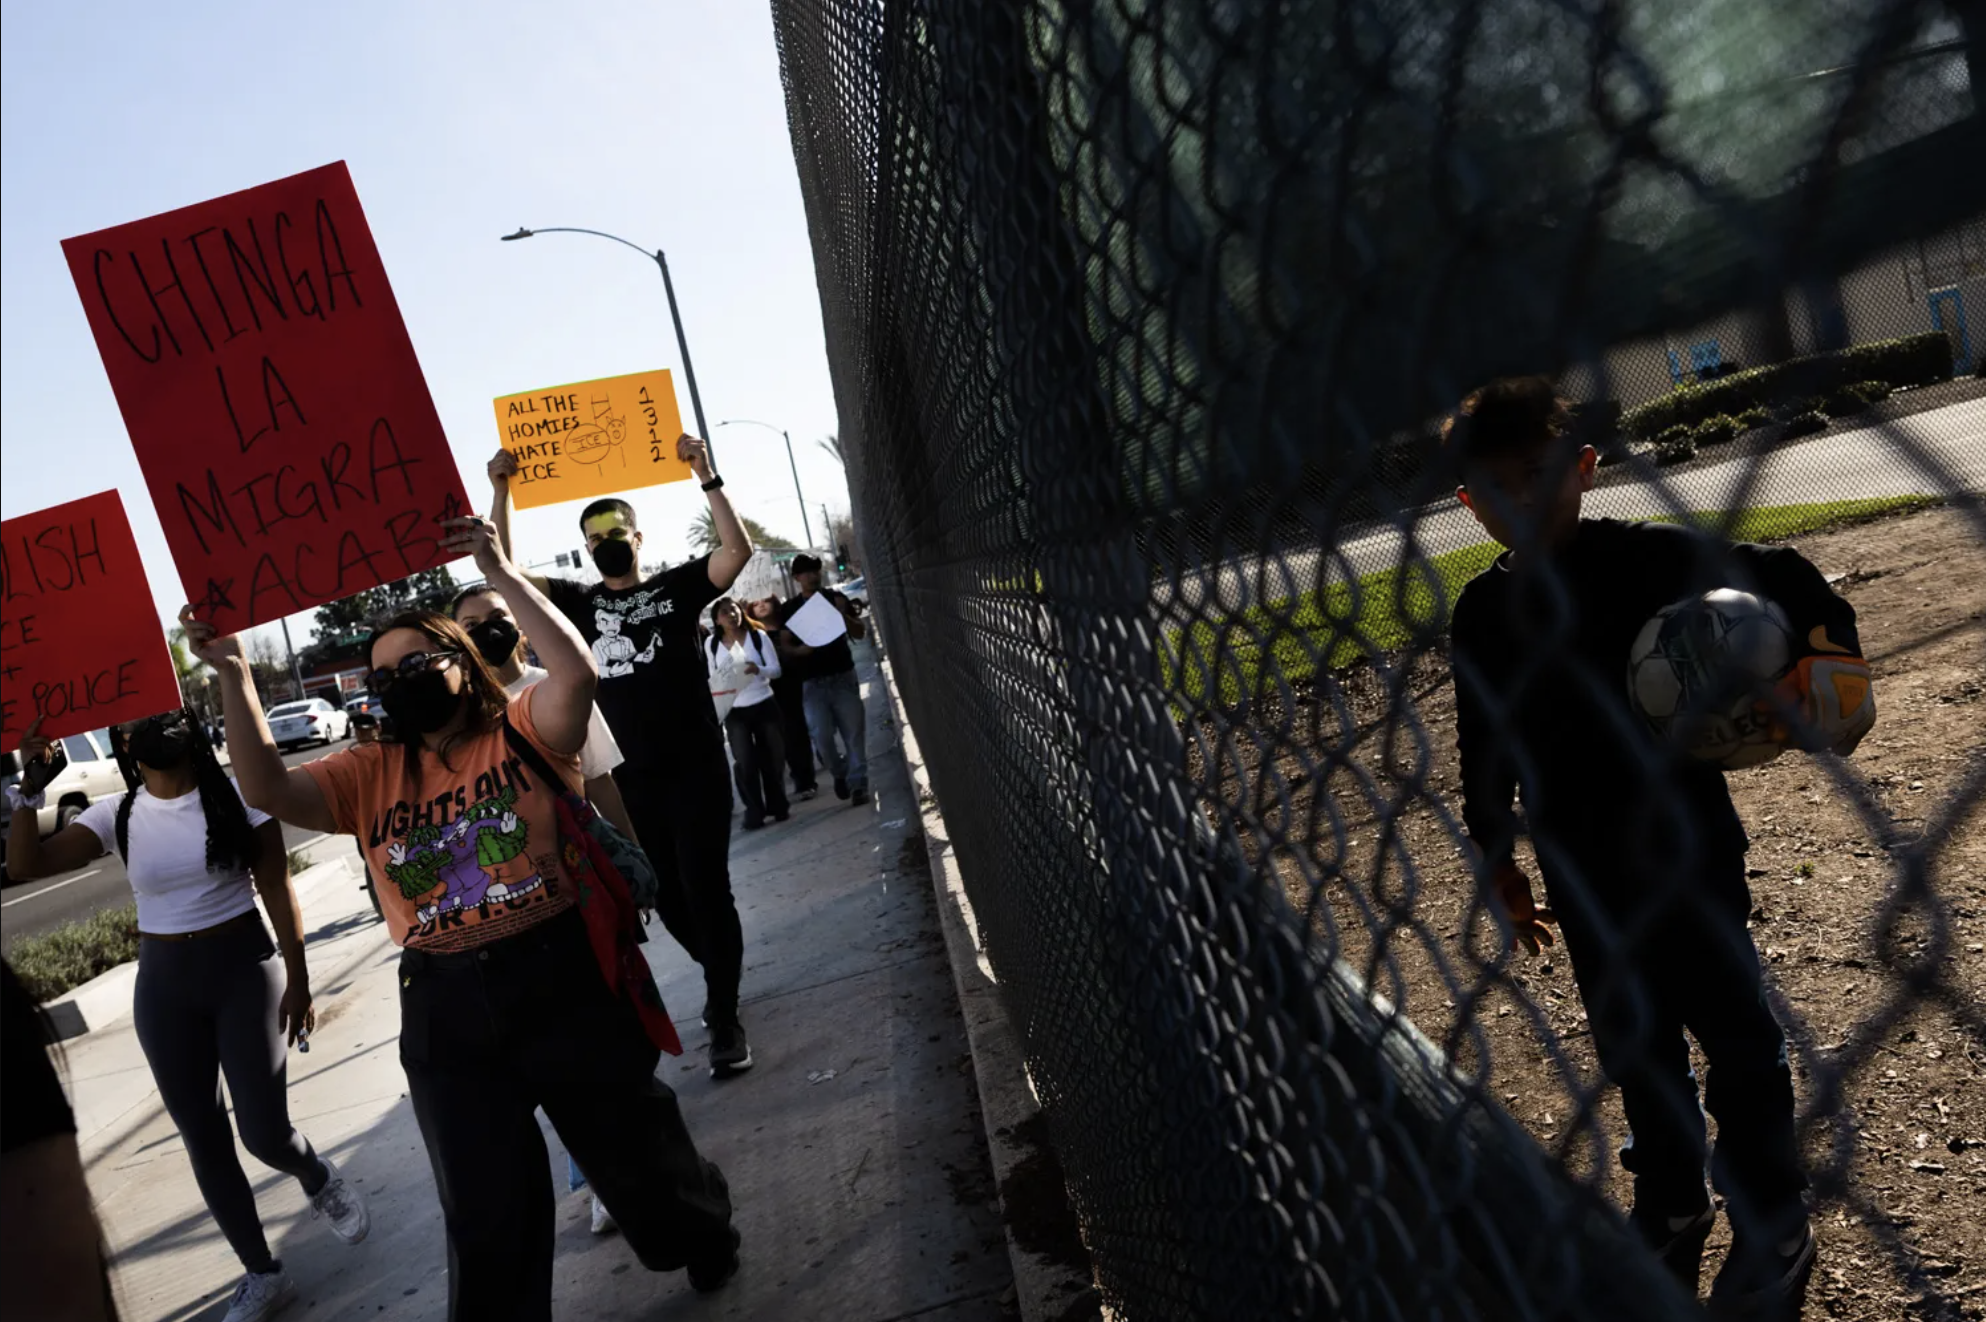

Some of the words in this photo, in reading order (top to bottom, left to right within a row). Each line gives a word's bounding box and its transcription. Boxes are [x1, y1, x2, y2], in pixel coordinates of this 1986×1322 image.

[94, 199, 363, 364] CHINGA
[216, 355, 307, 454] LA
[508, 398, 540, 418] ALL
[541, 393, 579, 414] THE
[508, 415, 580, 443] HOMIES
[513, 441, 563, 463] HATE
[578, 434, 601, 451] ICE
[176, 417, 423, 556] MIGRA
[519, 462, 562, 485] ICE
[1, 518, 106, 602] LISH
[250, 509, 441, 626] ACAB
[657, 599, 675, 615] ICE
[32, 659, 140, 718] POLICE
[369, 785, 467, 849] LIGHTS
[475, 757, 532, 800] OUT
